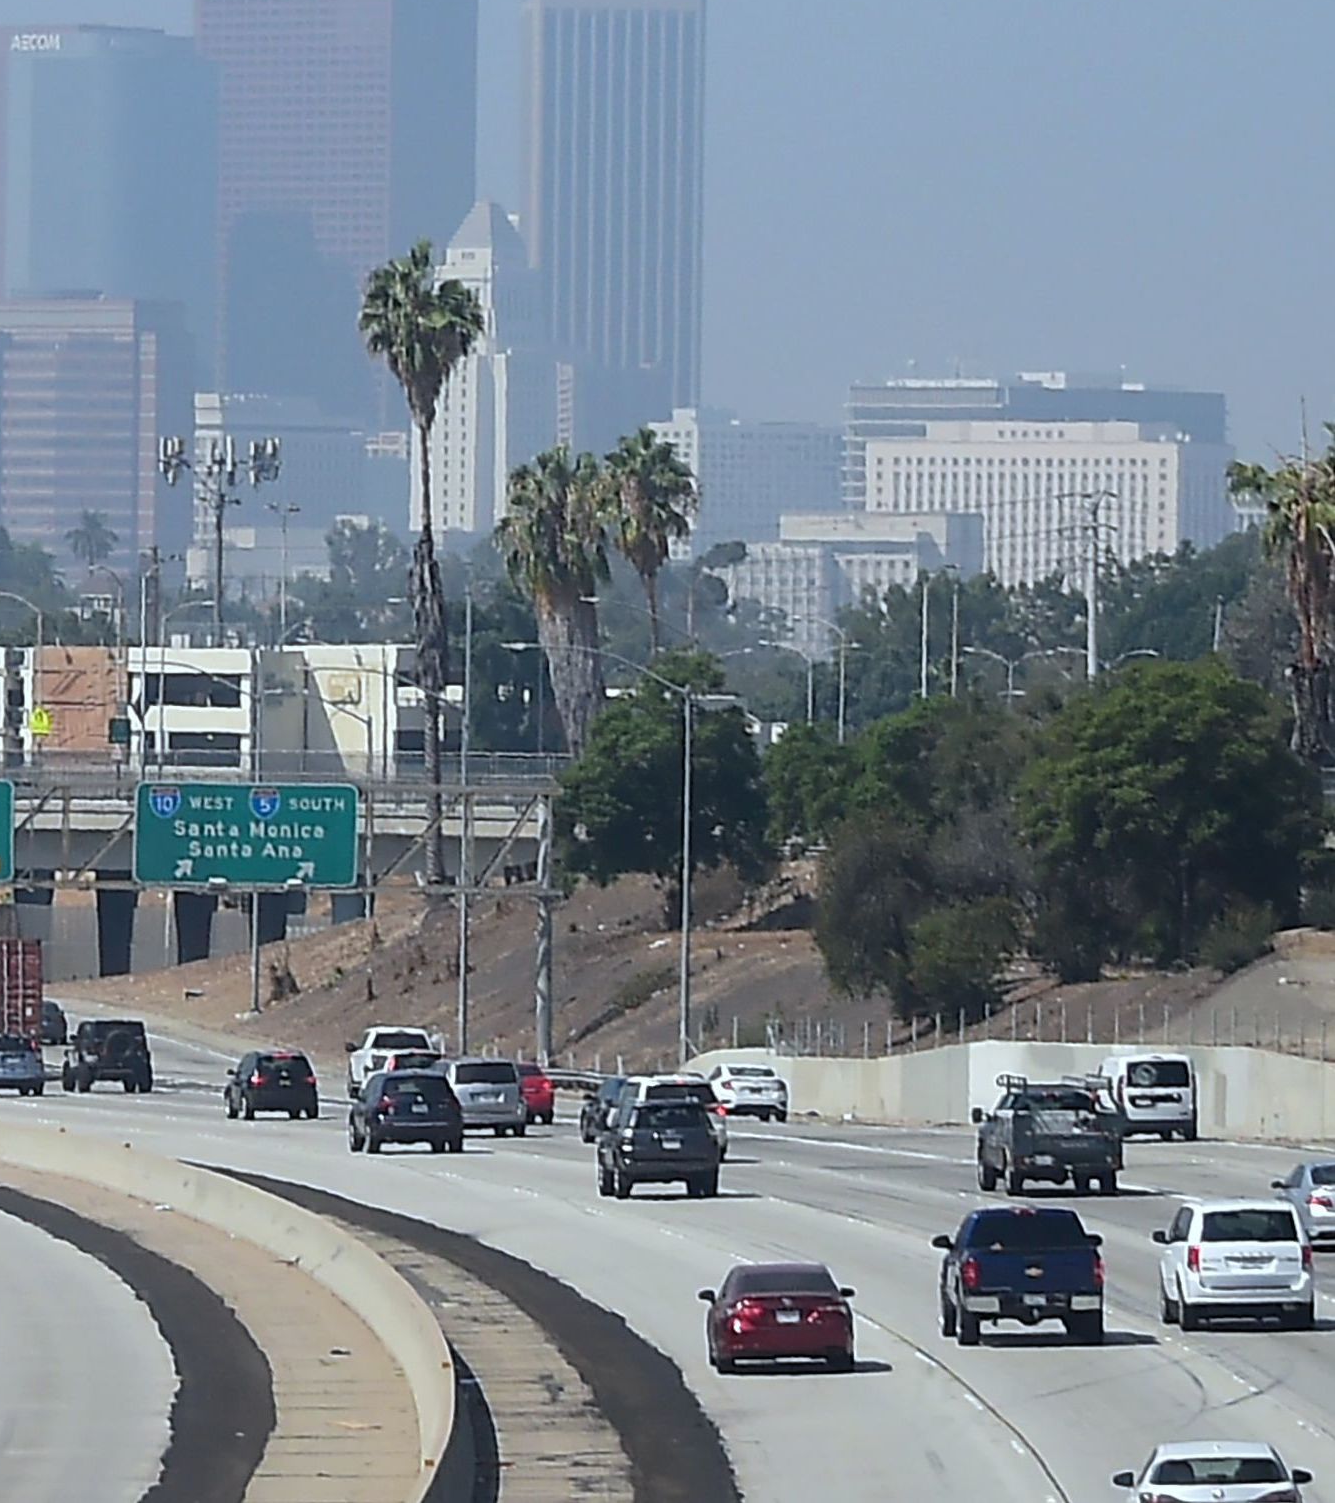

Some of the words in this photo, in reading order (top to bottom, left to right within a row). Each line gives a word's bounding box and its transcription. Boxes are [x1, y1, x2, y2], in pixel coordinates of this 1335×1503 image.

[11, 34, 60, 51] AECOM
[155, 796, 174, 812] 10
[188, 796, 234, 810] WEST
[259, 798, 271, 813] 5
[288, 798, 345, 811] SOUTH
[174, 819, 239, 837] Santa
[249, 820, 325, 839] Monica
[188, 841, 252, 859] Santa
[262, 842, 303, 859] Ana
